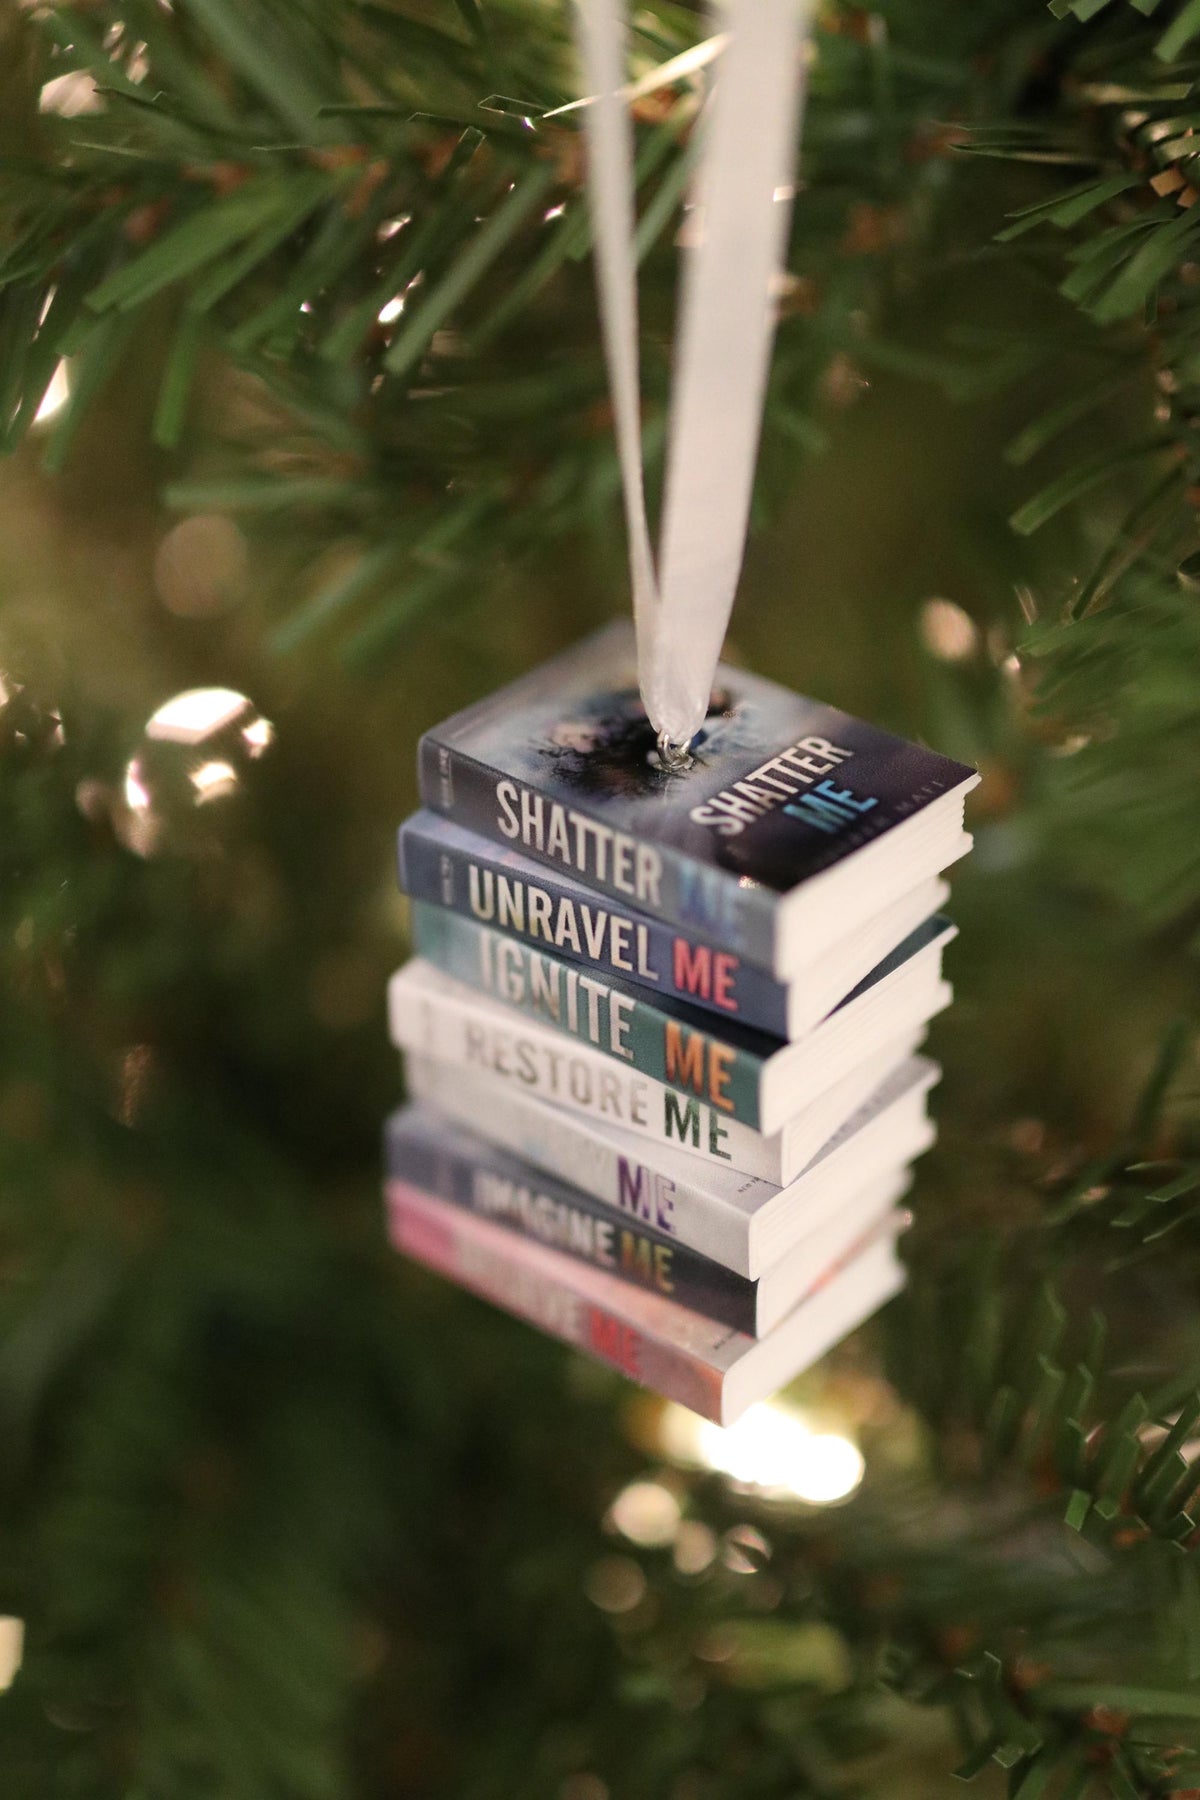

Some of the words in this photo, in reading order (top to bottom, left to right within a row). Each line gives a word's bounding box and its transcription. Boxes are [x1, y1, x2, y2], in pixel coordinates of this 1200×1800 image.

[690, 736, 854, 836] SHATTER
[782, 779, 879, 834] ME
[496, 780, 661, 907] SHATTER
[469, 864, 659, 981] UNRAVEL
[672, 935, 739, 1012] ME
[479, 930, 636, 1060] IGNITE
[664, 1019, 737, 1113] ME
[464, 1018, 649, 1127] RESTORE
[664, 1087, 732, 1161] ME
[617, 1154, 678, 1235] ME
[620, 1229, 676, 1294] ME
[588, 1305, 642, 1376] ME
